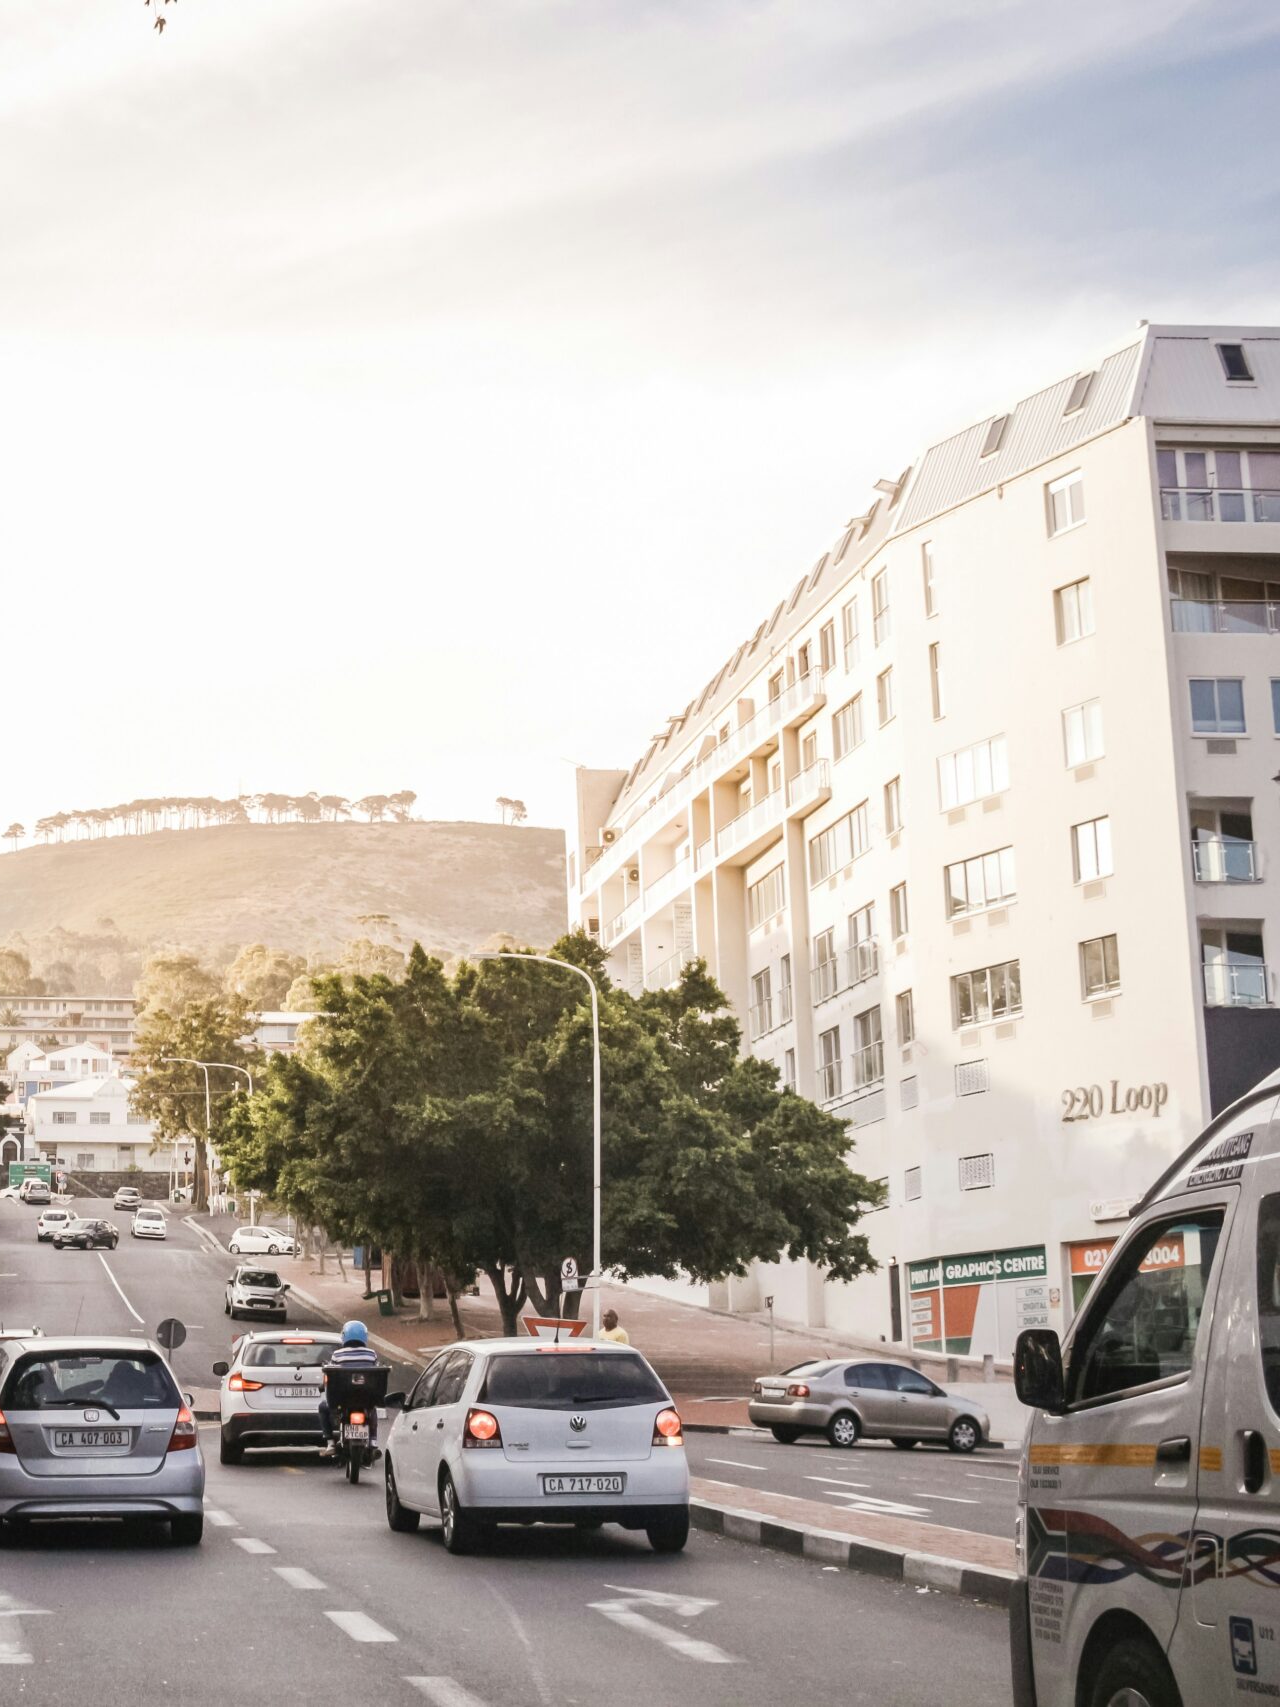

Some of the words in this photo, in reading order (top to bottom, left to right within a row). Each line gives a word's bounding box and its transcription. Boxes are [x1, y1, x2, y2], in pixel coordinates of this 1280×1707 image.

[1061, 1084, 1103, 1122] 220
[1109, 1079, 1168, 1117] Loop
[945, 1260, 1002, 1280] GRAPHICS
[1003, 1255, 1045, 1273] CENTRE
[1023, 1316, 1048, 1326] DISPLAY
[61, 1432, 74, 1445] CA
[549, 1478, 564, 1491] CA
